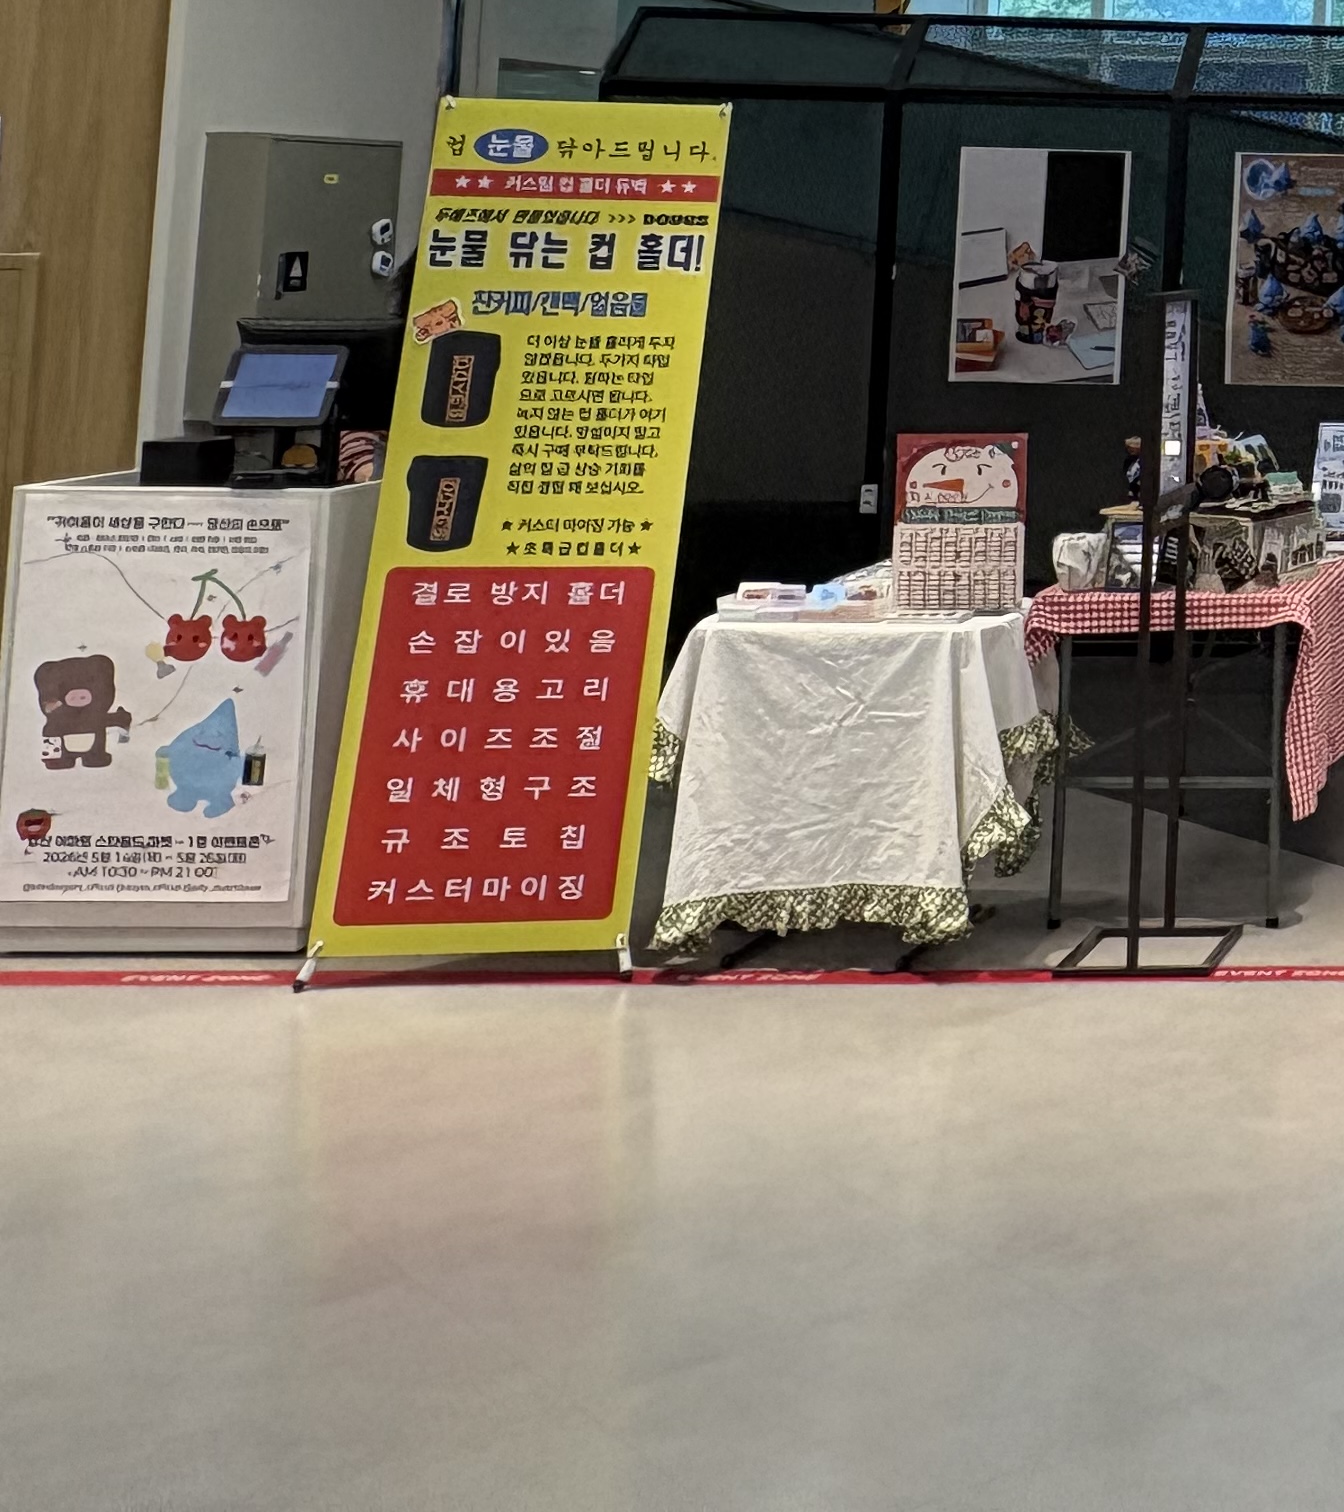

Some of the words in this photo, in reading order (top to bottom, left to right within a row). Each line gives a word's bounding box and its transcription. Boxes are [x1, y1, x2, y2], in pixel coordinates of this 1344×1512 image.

[487, 133, 535, 158] 눈물
[429, 229, 488, 268] 눈물
[509, 231, 568, 269] 닦는
[589, 233, 616, 271] 컵
[637, 233, 704, 272] 홀더!
[412, 581, 472, 607] 결로
[491, 581, 549, 606] 방지
[567, 581, 626, 606] 홀더
[367, 874, 586, 904] 커스터마이징
